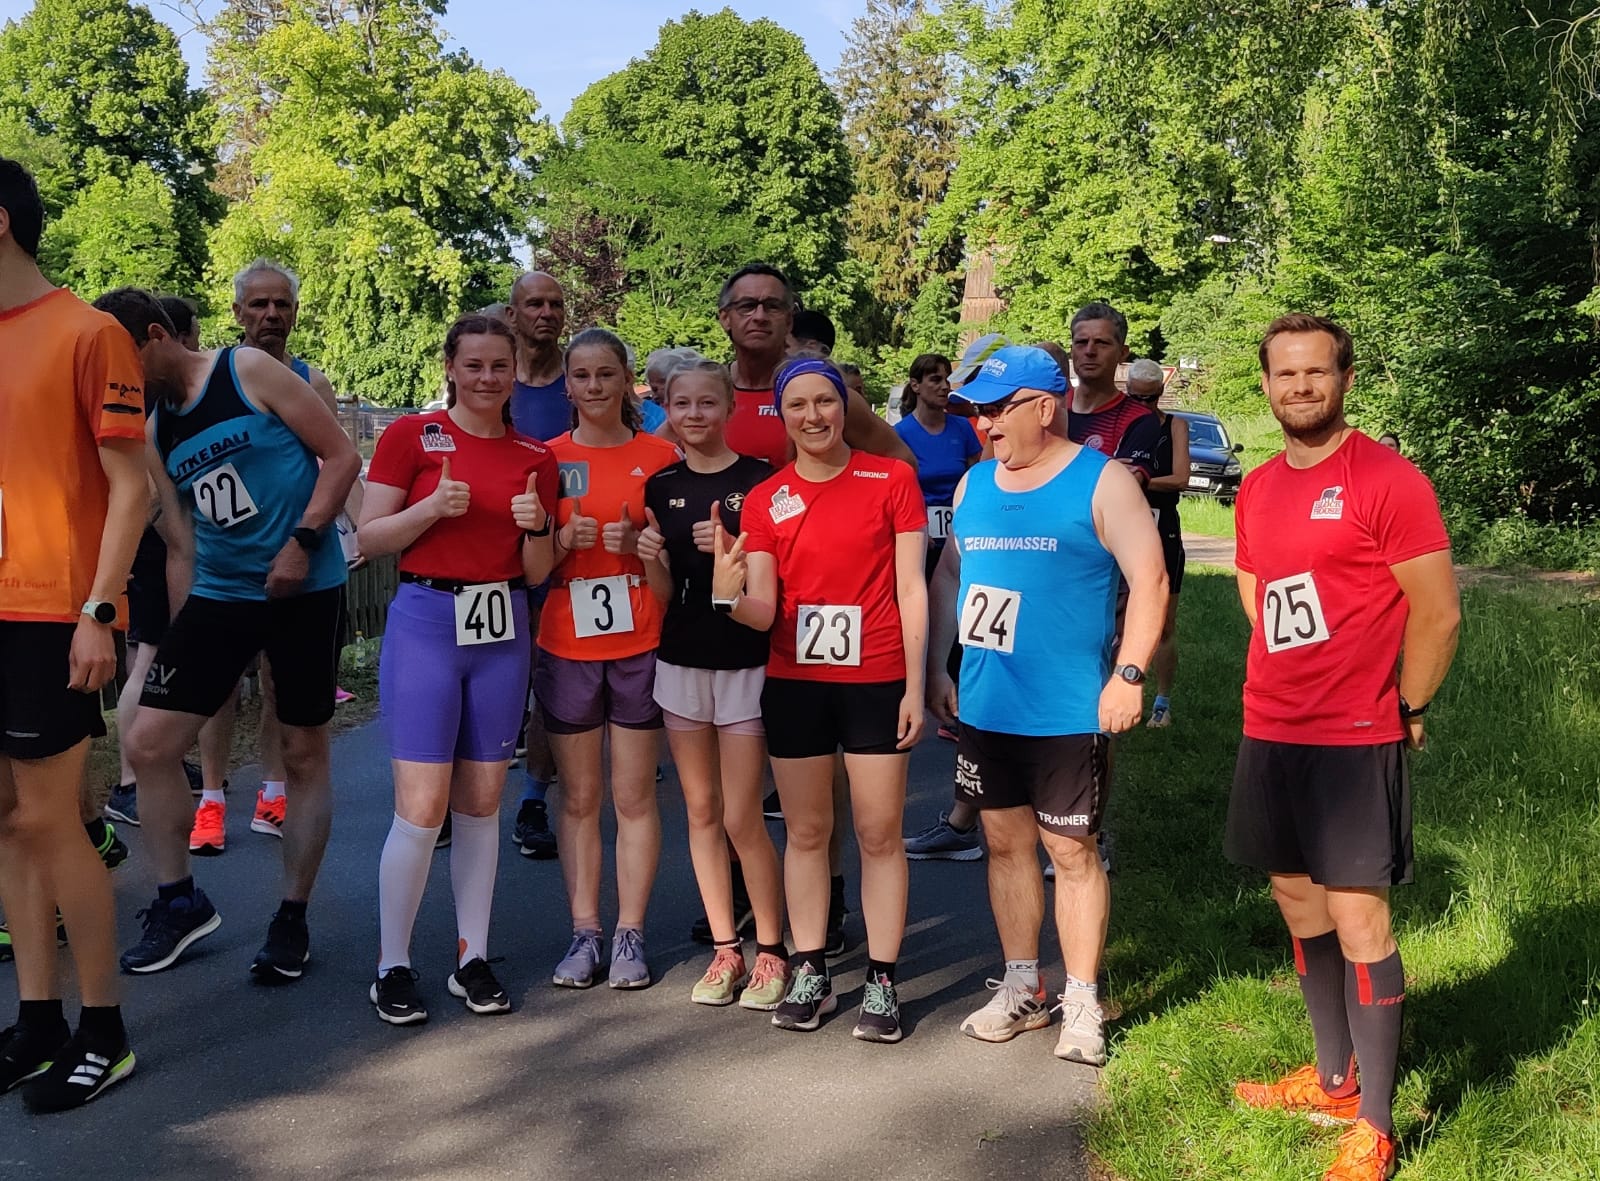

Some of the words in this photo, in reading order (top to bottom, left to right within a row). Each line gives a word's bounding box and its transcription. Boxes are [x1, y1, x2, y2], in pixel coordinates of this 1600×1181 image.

[200, 472, 252, 526] 22
[934, 510, 954, 536] 18
[973, 536, 1058, 552] EURAWASSER
[465, 590, 507, 640] 40
[592, 584, 613, 631] 3
[968, 592, 1012, 646] 24
[1267, 583, 1316, 645] 25
[805, 611, 850, 661] 23
[1036, 811, 1090, 826] TRAINER
